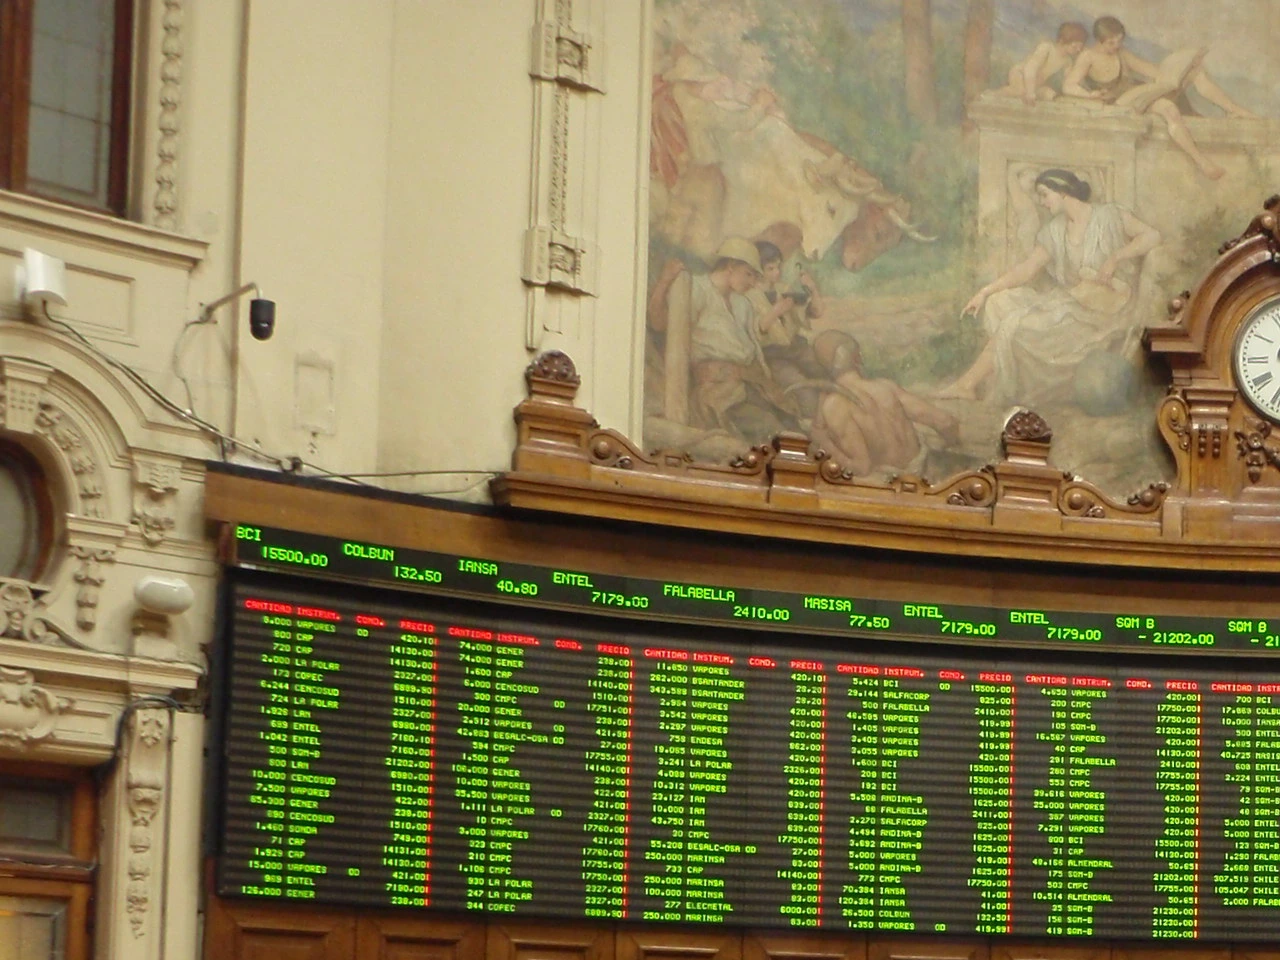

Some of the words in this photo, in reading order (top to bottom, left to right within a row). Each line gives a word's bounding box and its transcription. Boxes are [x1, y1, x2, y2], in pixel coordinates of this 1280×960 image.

[236, 526, 261, 542] BCI
[262, 546, 329, 567] 15500.00
[343, 543, 394, 561] COLBUN
[394, 565, 442, 583] 132.50
[458, 559, 498, 576] IANSA
[497, 579, 538, 596] 40.80
[553, 571, 593, 588] ENTEL
[591, 591, 649, 608] 7179.00
[663, 584, 735, 602] FALABELLA
[804, 596, 852, 612] MASISA
[904, 604, 943, 619] ENTEL
[734, 605, 790, 621] 2410.00
[1010, 611, 1049, 625] ENTEL
[849, 614, 890, 629] 77.50
[941, 620, 996, 636] 7179.00
[1115, 617, 1140, 630] SQM
[1145, 619, 1155, 630] B
[1228, 621, 1252, 633] SQM
[1258, 621, 1267, 633] B
[1047, 626, 1102, 641] 7179.00
[1153, 632, 1215, 645] 21202.00
